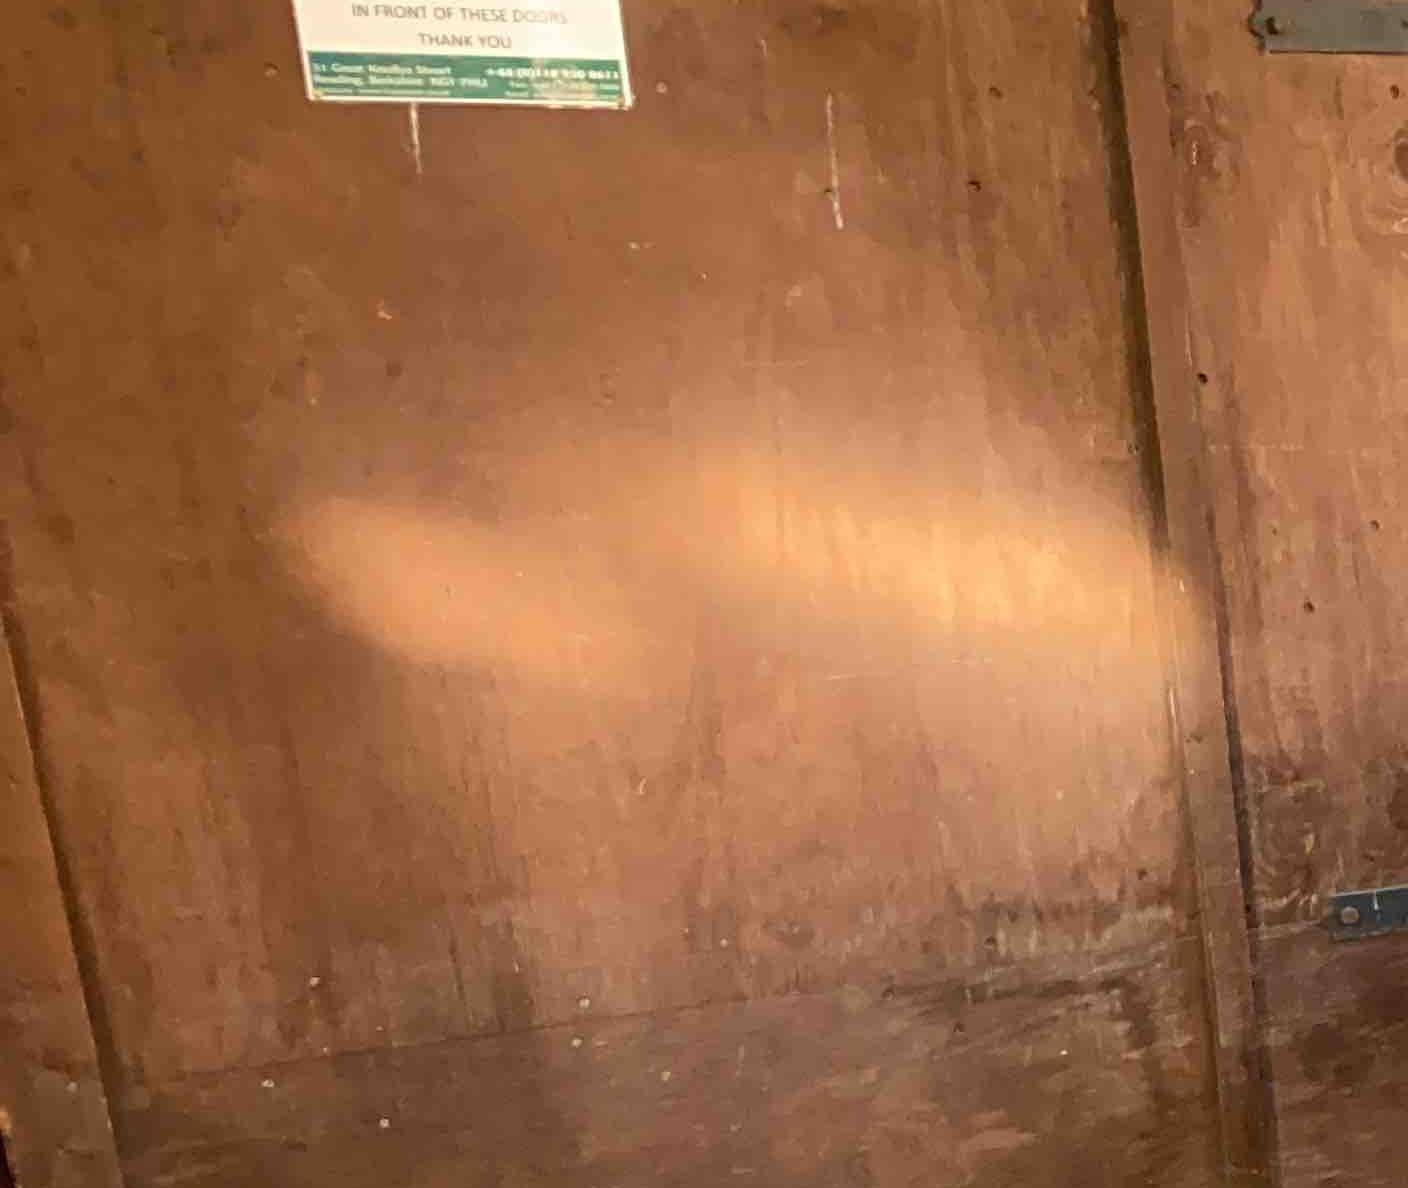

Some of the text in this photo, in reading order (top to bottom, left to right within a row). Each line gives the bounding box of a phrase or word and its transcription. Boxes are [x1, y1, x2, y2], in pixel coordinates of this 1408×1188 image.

[351, 3, 370, 17] IN
[374, 4, 427, 20] FRONT
[433, 6, 454, 21] OF
[459, 7, 508, 23] THESE
[418, 31, 513, 49] THANK YOU
